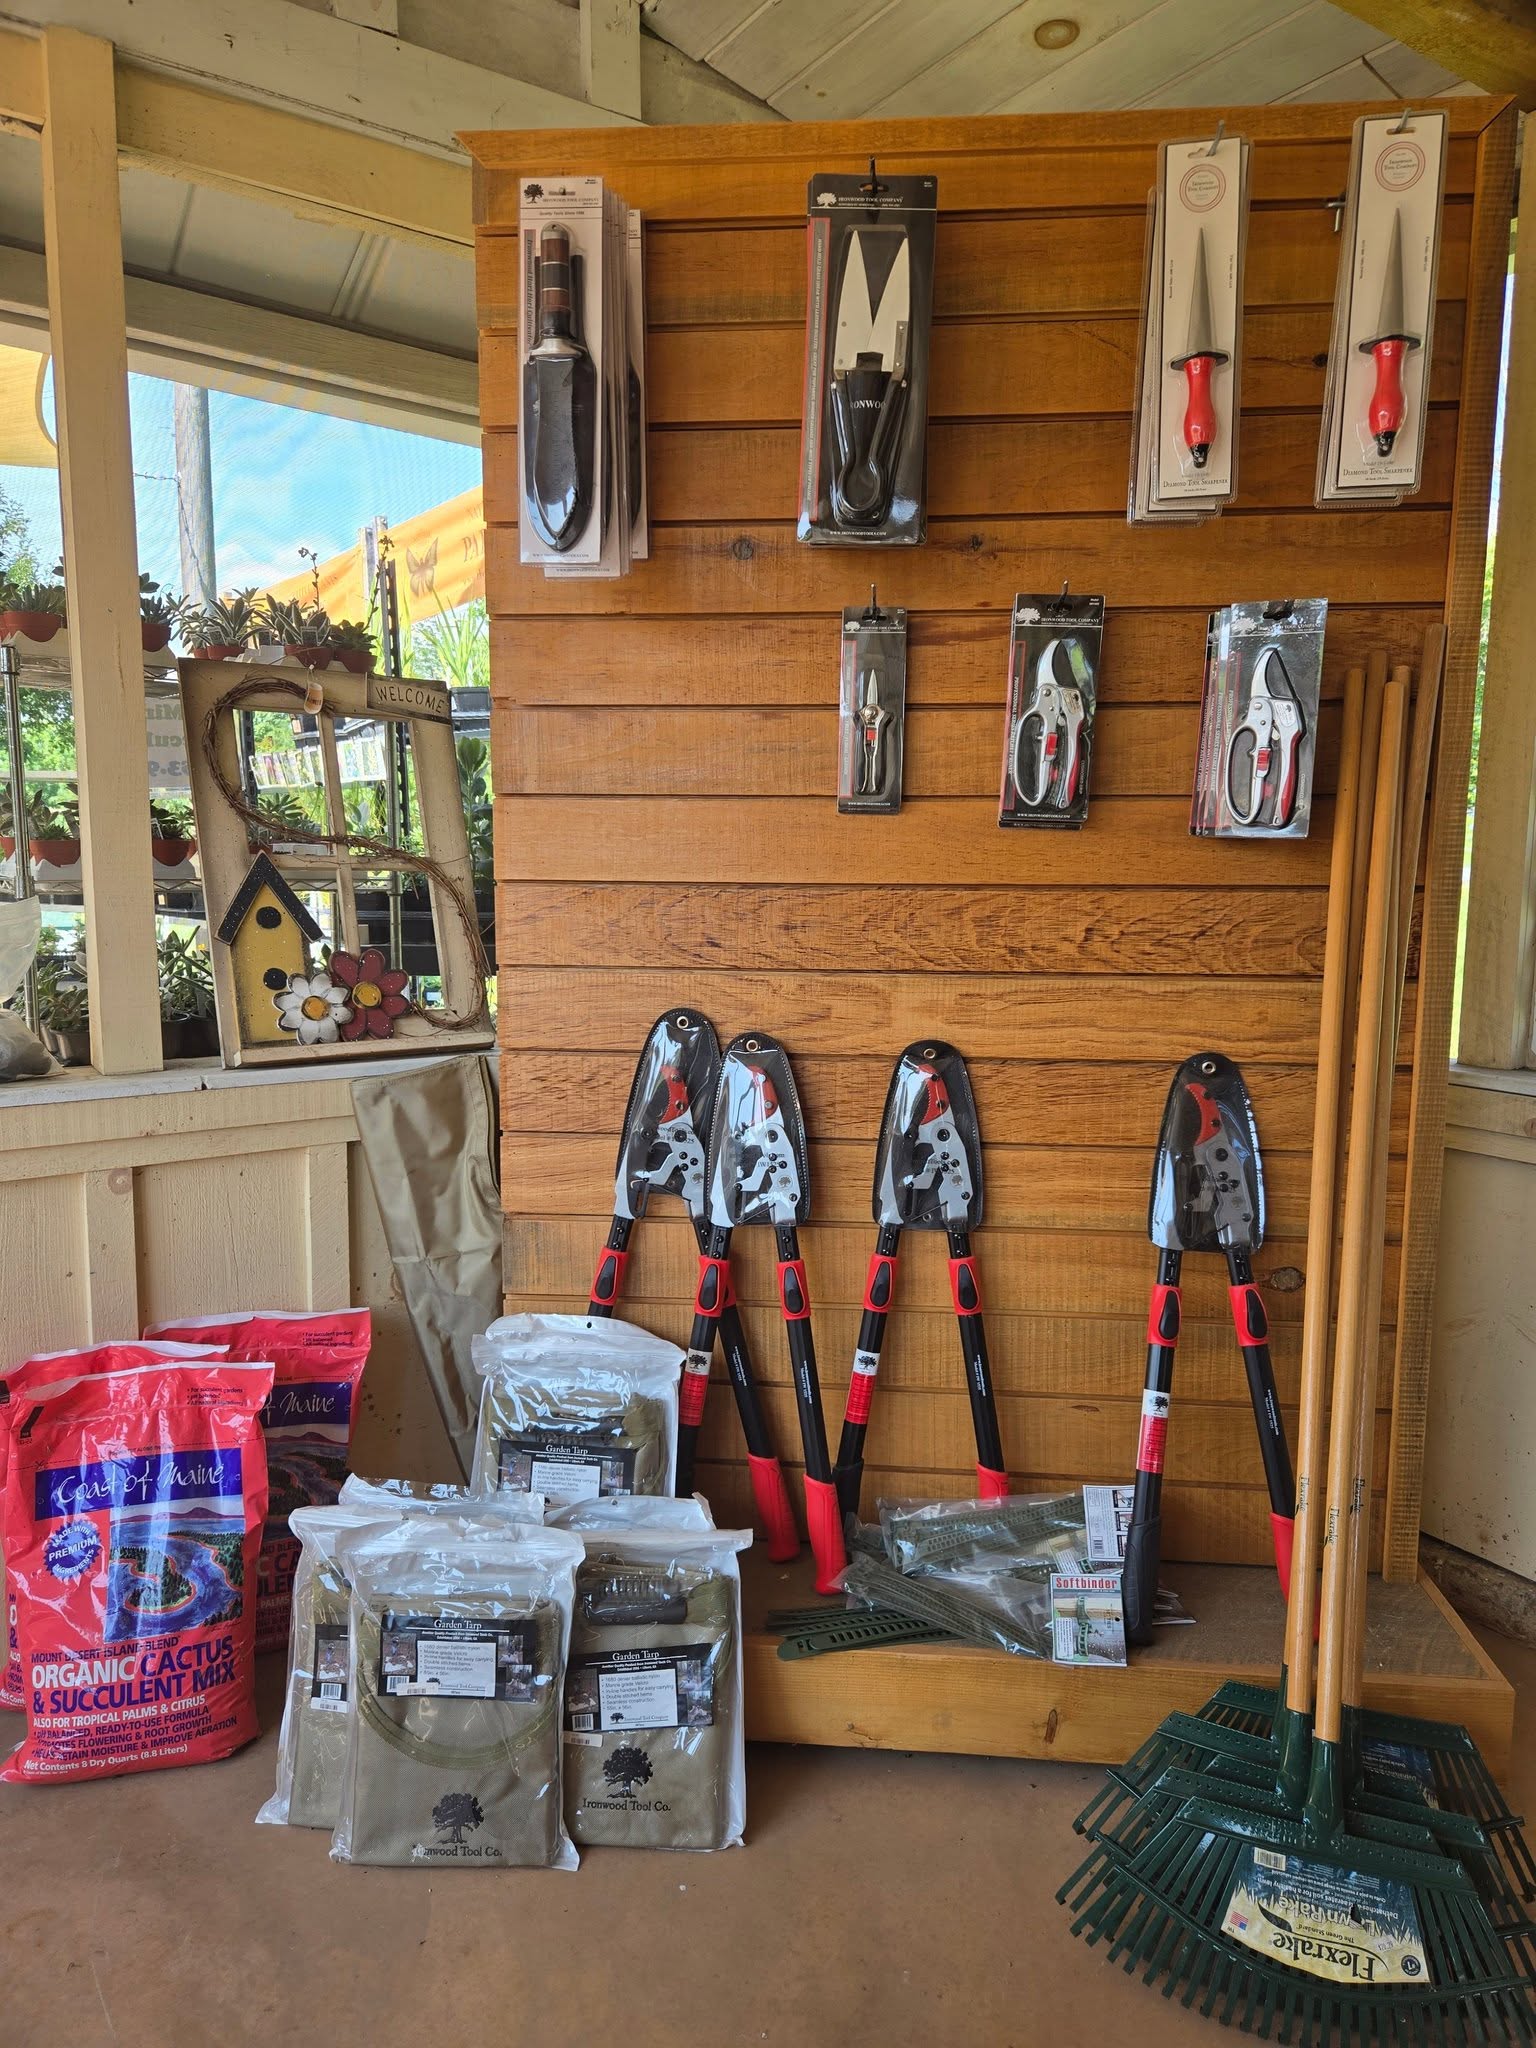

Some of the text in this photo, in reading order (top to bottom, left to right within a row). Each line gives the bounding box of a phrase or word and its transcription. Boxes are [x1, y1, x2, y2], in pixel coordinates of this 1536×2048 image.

[376, 686, 444, 714] WELCOME
[280, 1392, 335, 1416] Maine
[546, 1444, 588, 1456] Garden Tarp
[58, 1461, 224, 1504] Coast of Maine
[52, 1525, 92, 1548] MADE WITH
[1328, 1508, 1340, 1546] Flexrake
[48, 1535, 98, 1562] PREMIUM
[53, 1548, 95, 1575] INGREDIENTS
[1056, 1578, 1118, 1588] Softbinder
[434, 1620, 482, 1632] Garden Tarp
[31, 1637, 178, 1664] MOUNT DESERT ISLAND BLEND
[32, 1656, 136, 1689] ORGANIC
[140, 1635, 234, 1678] CACTUS
[612, 1650, 660, 1660] Garden Tarp
[33, 1691, 44, 1714] &
[50, 1673, 186, 1715] SUCCULENT
[192, 1659, 236, 1694] MIX
[33, 1694, 206, 1728] ALSO FOR TROPICAL PALMS & CITRUS
[48, 1728, 94, 1740] BALANCED,
[96, 1719, 162, 1736] READY-TO-USE
[164, 1706, 210, 1724] FORMULA
[78, 1733, 132, 1749] FLOWERING
[134, 1732, 142, 1740] &
[144, 1728, 170, 1740] ROOT
[172, 1715, 212, 1734] GROWTH
[91, 1743, 139, 1758] MOISTURE
[140, 1742, 149, 1750] &
[150, 1732, 193, 1747] IMPROVE
[194, 1715, 238, 1737] AERATION
[24, 1759, 38, 1770] Net
[40, 1760, 80, 1772] Contents
[90, 1758, 106, 1768] Dry
[108, 1753, 138, 1766] Quarts
[140, 1748, 158, 1760] (8.8
[159, 1744, 188, 1757] Liters)
[582, 1797, 672, 1812] Ironwood Tool Co.
[460, 1845, 482, 1858] Tool
[484, 1846, 502, 1858] Co.
[1302, 1889, 1312, 1897] for
[1279, 1896, 1322, 1922] Rake
[1298, 1924, 1354, 1944] The Green Standard
[1272, 1932, 1376, 1982] Flexrake
